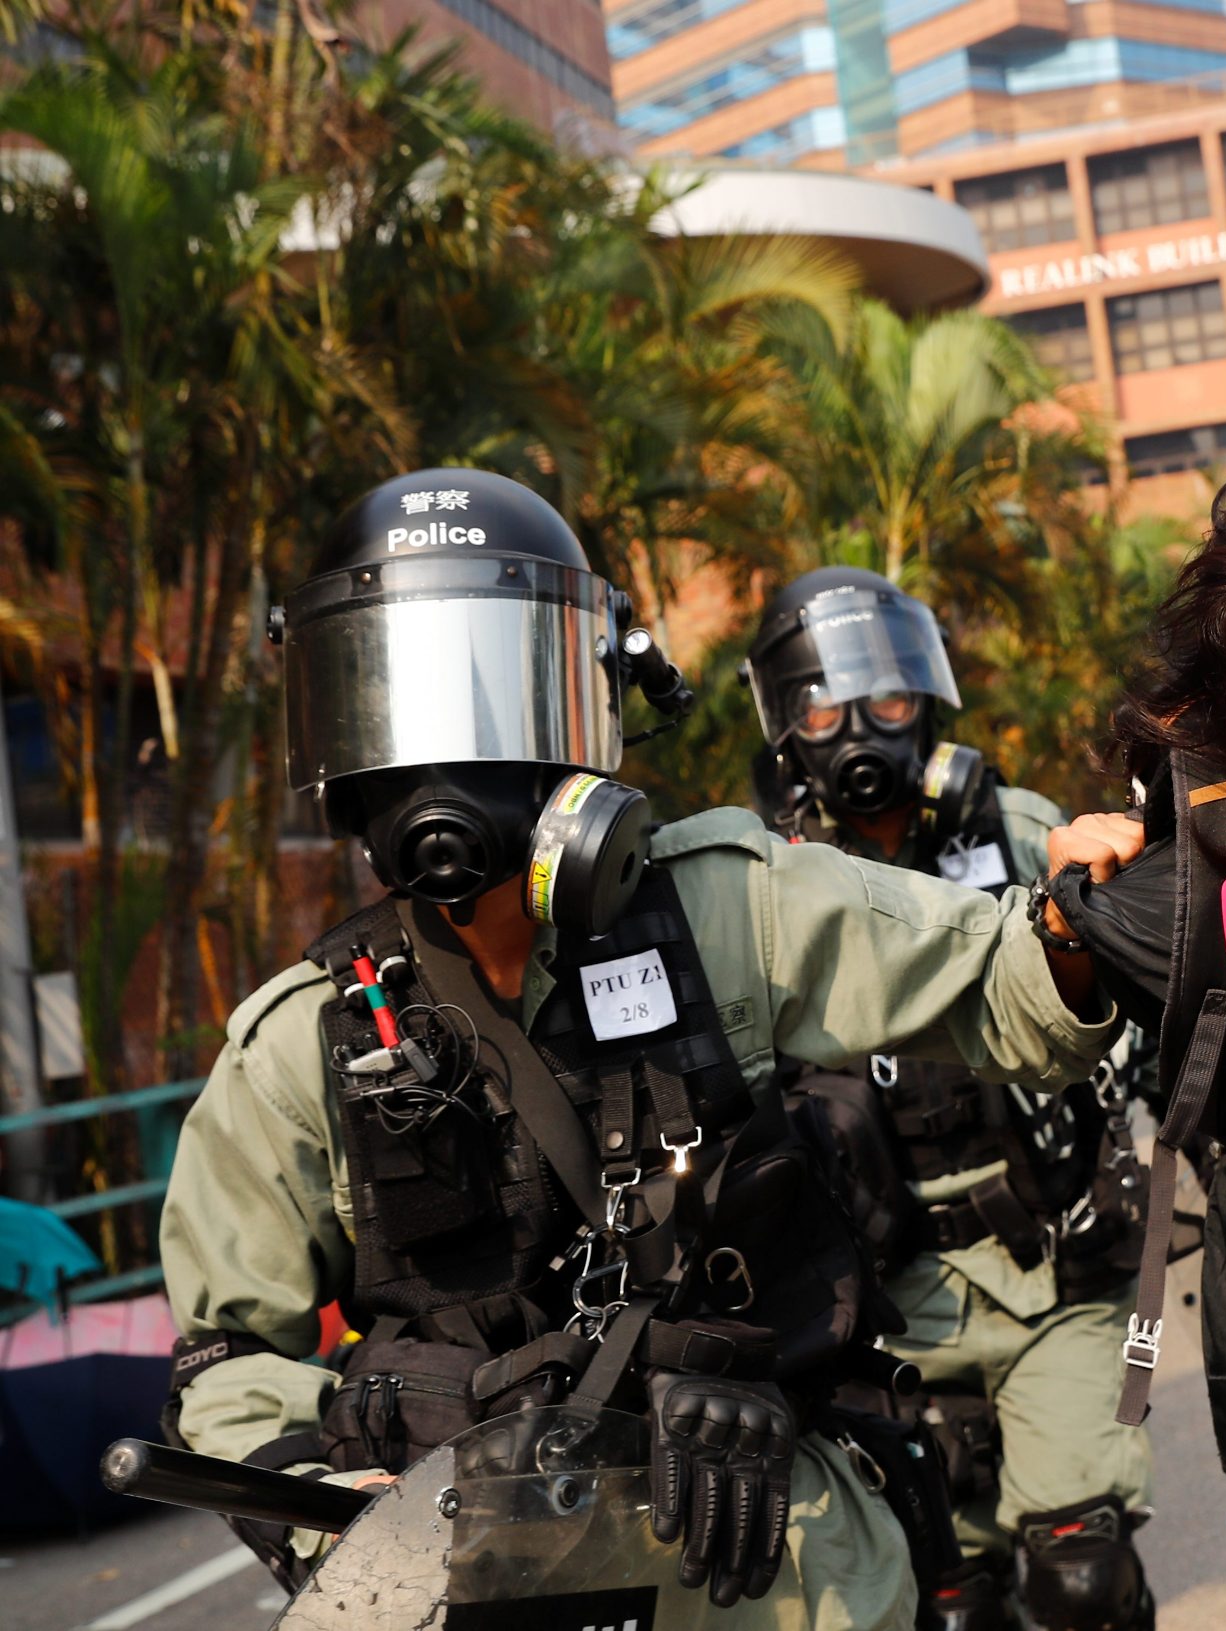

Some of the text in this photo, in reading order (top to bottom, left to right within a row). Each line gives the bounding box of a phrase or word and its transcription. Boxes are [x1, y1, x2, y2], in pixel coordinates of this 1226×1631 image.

[1001, 248, 1141, 297] REALINK
[400, 488, 471, 515] 警察
[388, 521, 487, 553] Police
[590, 964, 664, 998] PTU Z1
[619, 1002, 650, 1023] 2/8
